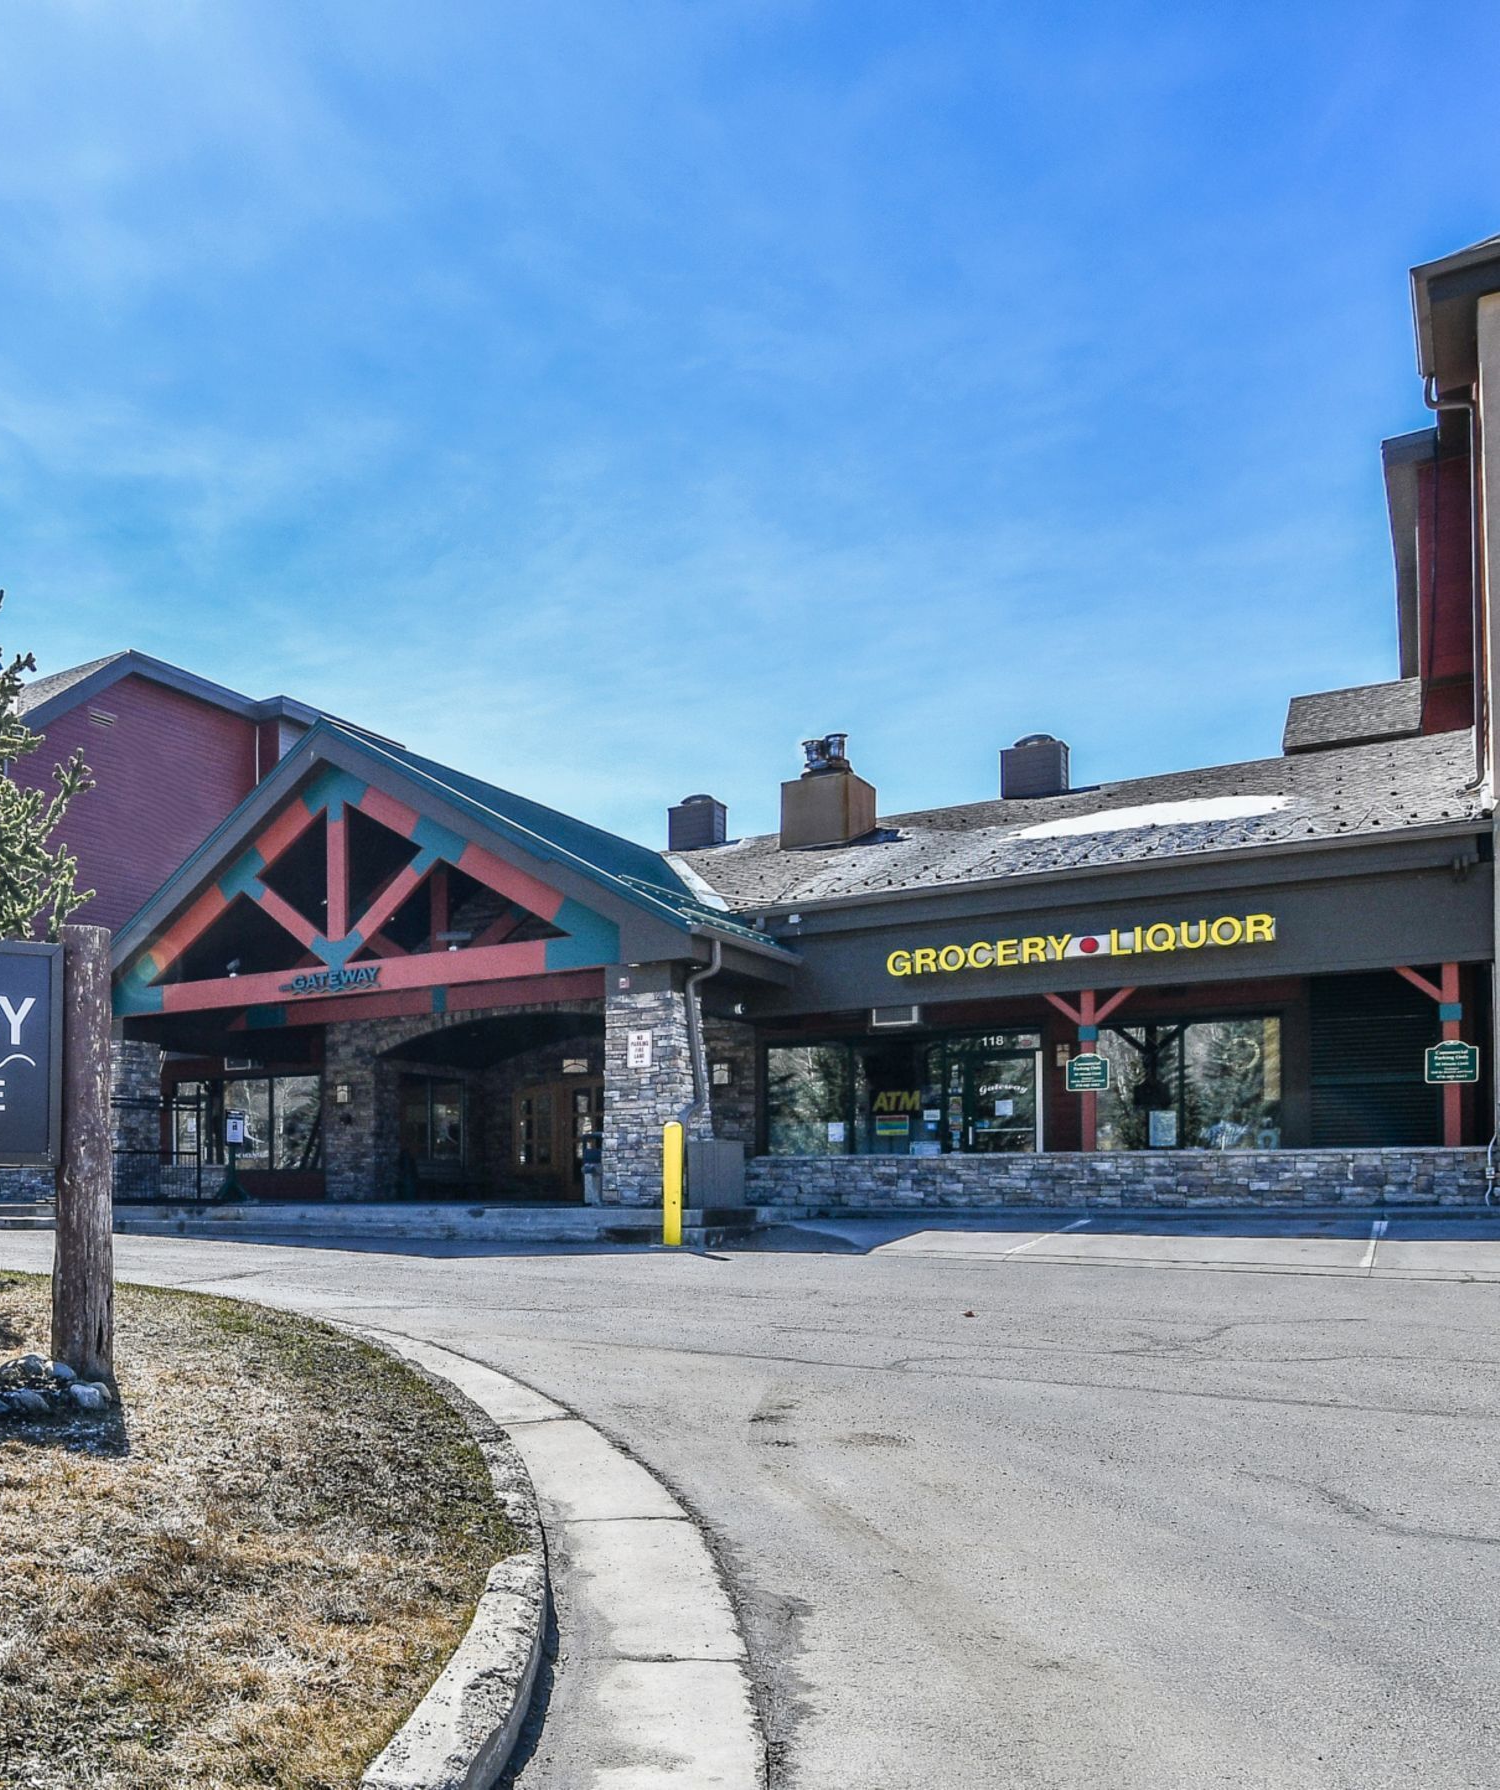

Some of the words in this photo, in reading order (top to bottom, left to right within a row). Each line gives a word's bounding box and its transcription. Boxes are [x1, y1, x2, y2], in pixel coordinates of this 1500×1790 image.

[886, 933, 1071, 977] GROCERY
[1110, 913, 1274, 956] LIQUOR
[292, 967, 380, 989] GATEWAY
[981, 1035, 1004, 1046] 118
[979, 1083, 1028, 1096] Gateway
[872, 1090, 920, 1112] ATM
